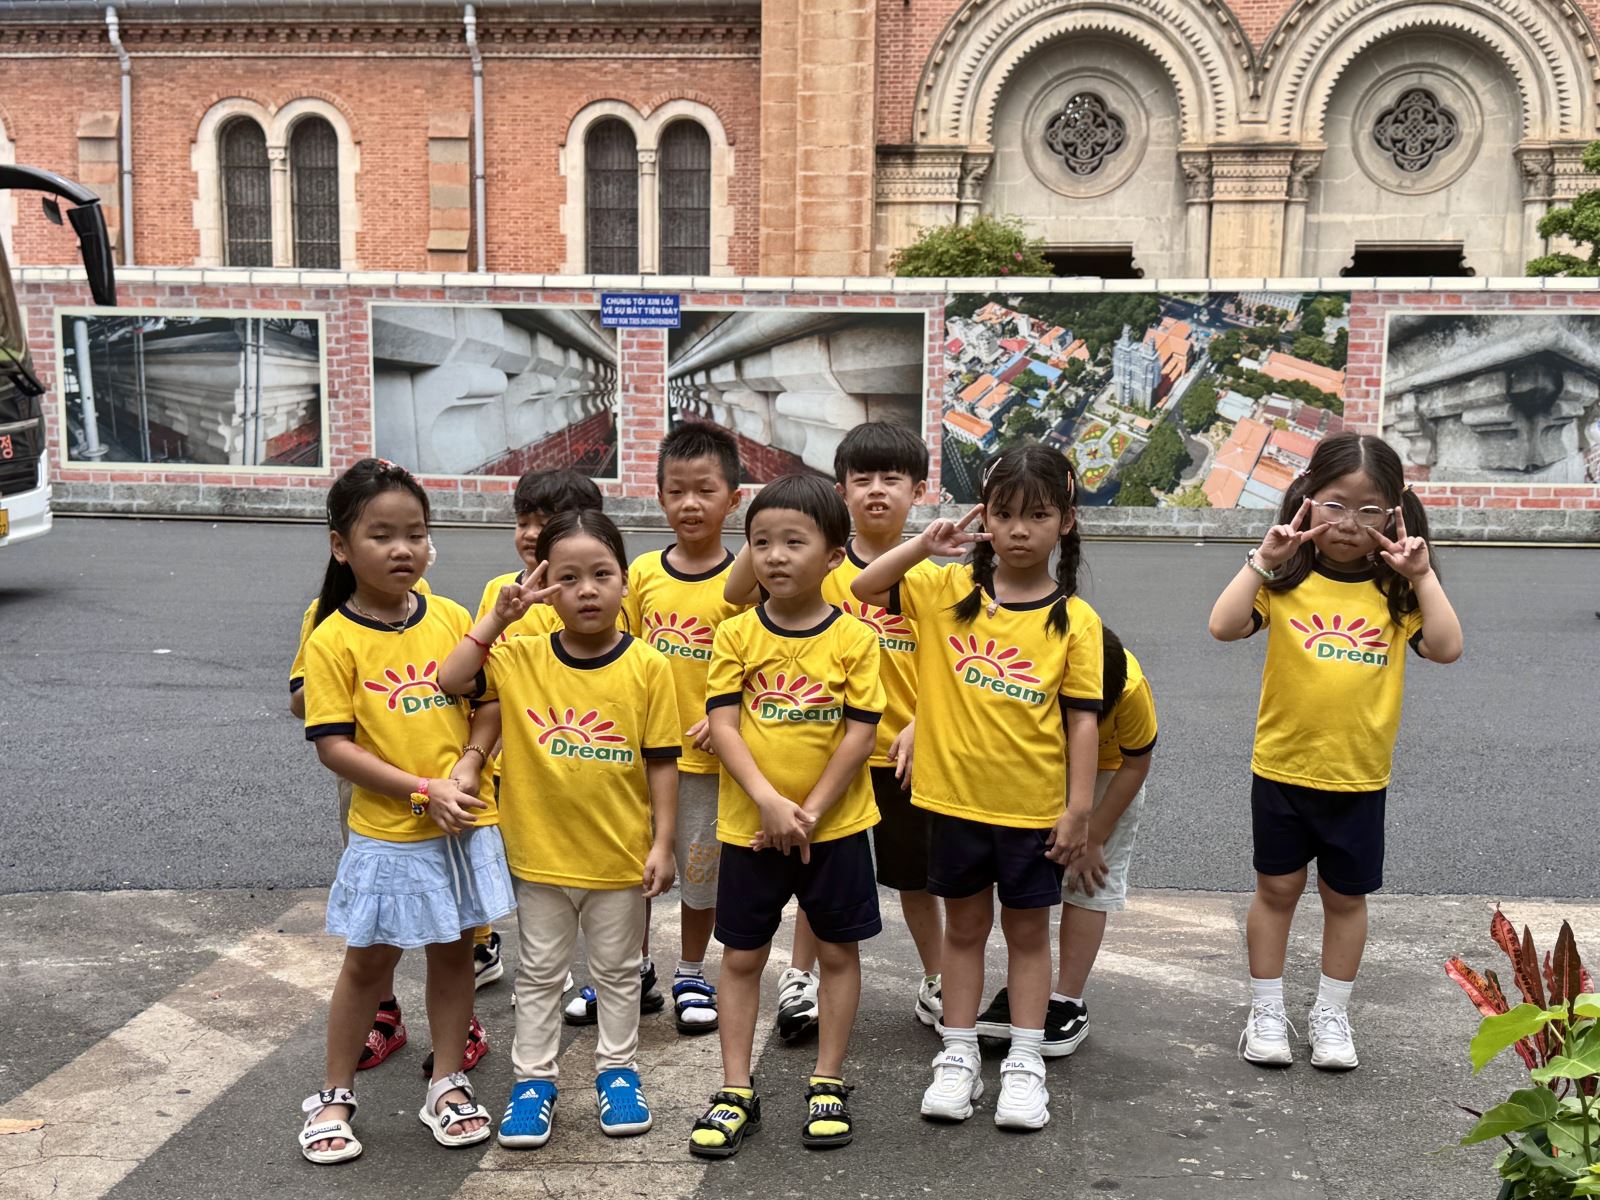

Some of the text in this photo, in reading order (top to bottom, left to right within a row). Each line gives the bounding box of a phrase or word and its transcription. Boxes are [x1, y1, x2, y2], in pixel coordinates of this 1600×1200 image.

[964, 666, 1047, 704] Dream
[402, 694, 457, 714] Drea
[761, 702, 842, 721] Dream
[550, 738, 633, 763] Dream
[945, 1055, 964, 1063] FILA
